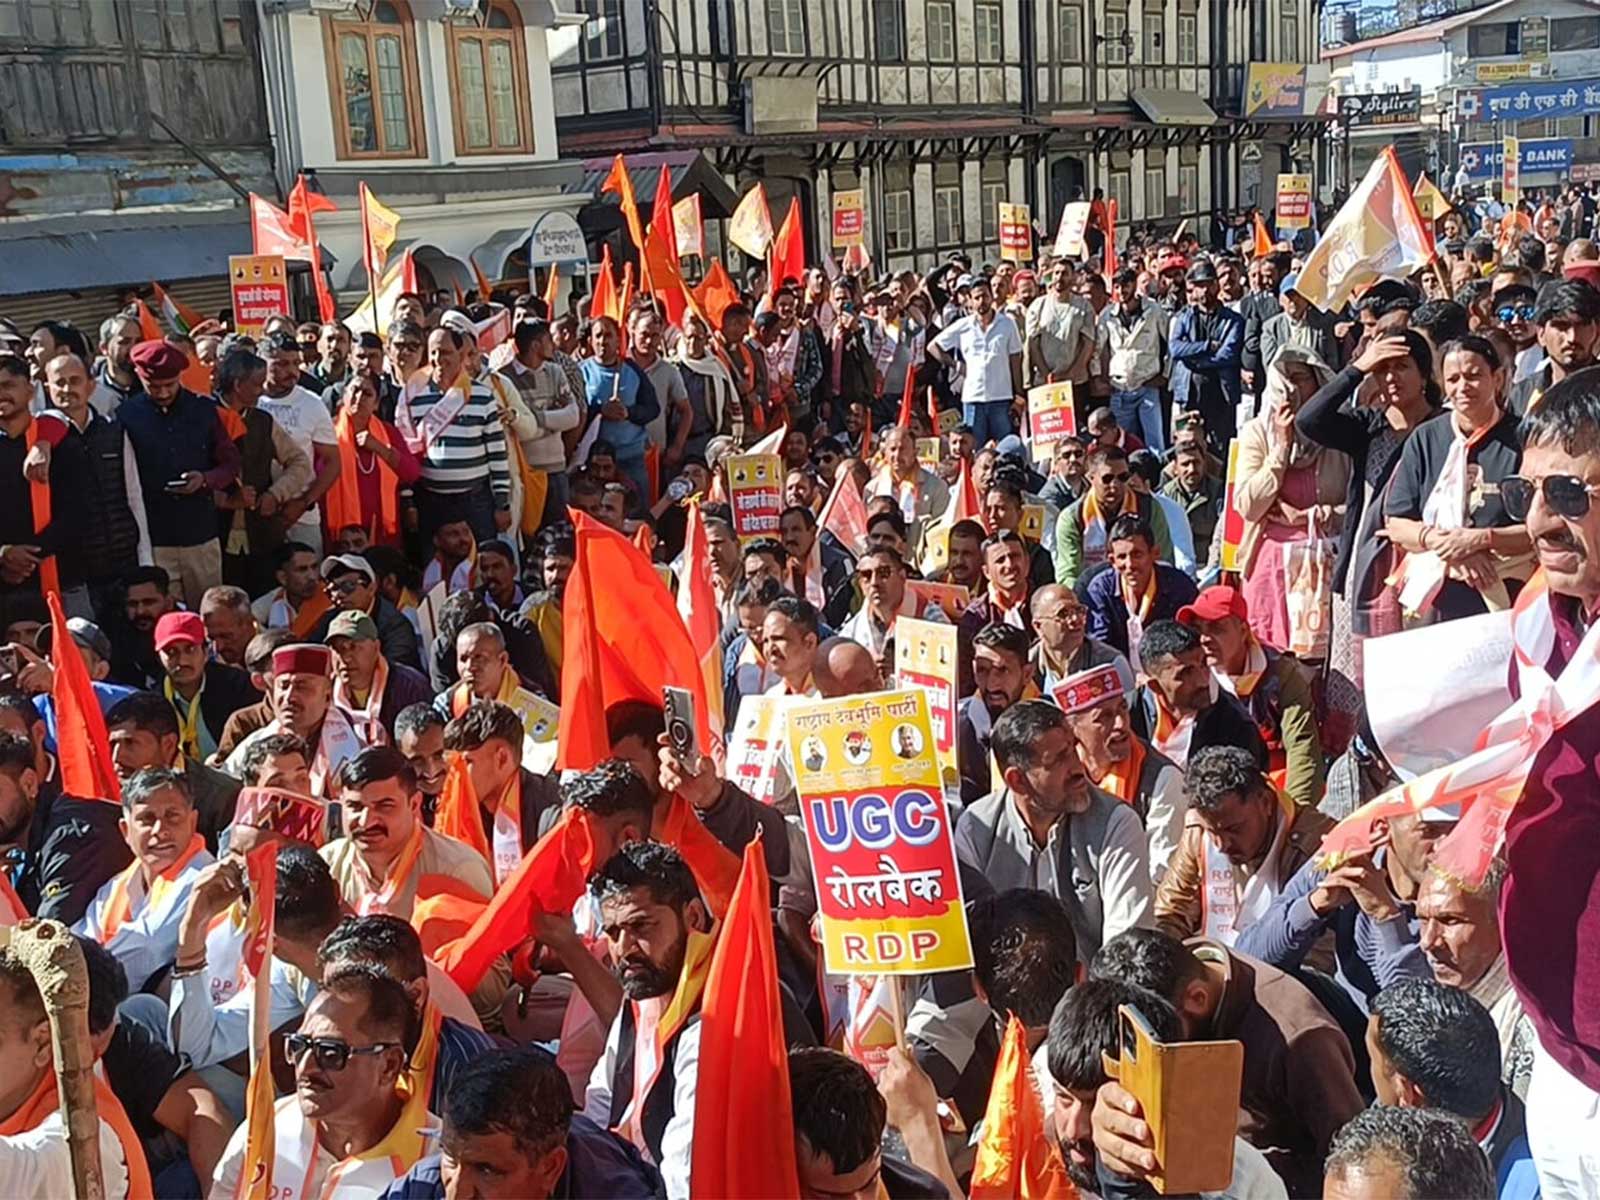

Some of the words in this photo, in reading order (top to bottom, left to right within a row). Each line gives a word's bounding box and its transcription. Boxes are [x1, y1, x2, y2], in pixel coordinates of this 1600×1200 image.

[1527, 149, 1567, 162] BANK
[886, 694, 917, 716] पार्टी
[810, 788, 941, 851] UGC
[825, 855, 944, 909] रोलबैक
